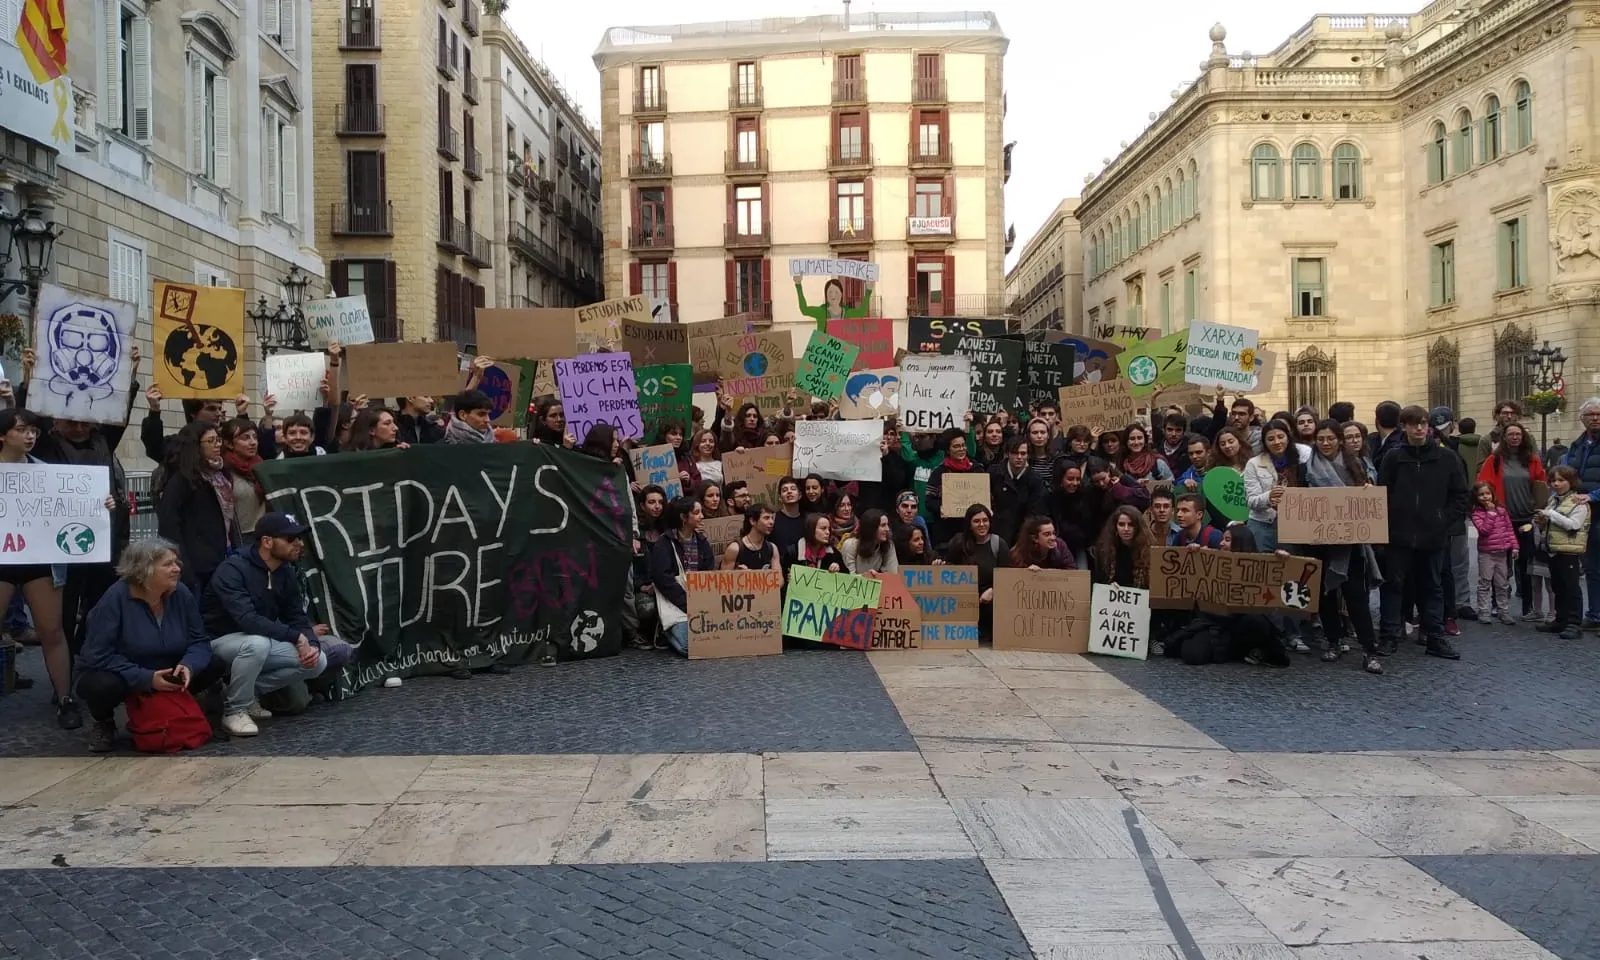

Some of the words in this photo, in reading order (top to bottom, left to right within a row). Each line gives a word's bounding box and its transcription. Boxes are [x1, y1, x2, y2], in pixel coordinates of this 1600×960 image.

[13, 72, 49, 105] EXILIATS
[792, 259, 832, 274] CLIMATE
[836, 262, 874, 279] STRIKE
[578, 297, 643, 323] ESTUDIANTS
[624, 325, 686, 343] ESTUDIANTS
[1120, 326, 1149, 341] HAY
[1201, 325, 1245, 347] XARXA
[758, 338, 785, 363] FUTUR
[827, 338, 842, 351] NO
[957, 337, 997, 352] AQUEST
[815, 346, 844, 364] CANVI
[556, 362, 568, 377] SI
[573, 359, 608, 375] PERDEMOS
[611, 359, 632, 374] ESTA
[927, 362, 955, 379] juguem
[276, 376, 312, 391] GRETA
[561, 375, 631, 399] LUCHA
[727, 377, 766, 395] NOSTRE
[766, 373, 794, 389] FUTUR
[805, 374, 830, 389] CANVI
[808, 383, 833, 398] XIP!
[1091, 382, 1127, 397] CLIMA
[940, 387, 955, 400] del
[1103, 396, 1132, 411] BANCO
[572, 402, 588, 414] LAS
[598, 399, 640, 412] PERDEMOS
[905, 406, 954, 429] DEMÀ
[56, 472, 92, 495] IS
[15, 496, 102, 518] WEALTH
[265, 464, 569, 560] RIDAYS
[1344, 495, 1384, 520] JAUME
[1312, 521, 1371, 542] 16:30
[1160, 548, 1232, 582] SAVE
[1237, 557, 1286, 587] THE
[687, 571, 733, 594] HUMAN
[736, 571, 779, 594] CHANGE
[793, 566, 828, 591] WE
[834, 572, 881, 600] WANT
[903, 569, 933, 588] THE
[941, 569, 978, 585] REAL
[305, 543, 504, 649] UTURE
[816, 590, 840, 607] YOU
[840, 594, 855, 608] TO
[1109, 589, 1142, 607] DRET
[1165, 575, 1263, 607] PLANET
[721, 593, 756, 614] NOT
[1098, 607, 1109, 616] a
[1111, 608, 1132, 619] un
[689, 610, 735, 634] Climate
[786, 597, 874, 648] PANIC!
[1099, 619, 1137, 635] AIRE
[1102, 634, 1141, 653] NET
